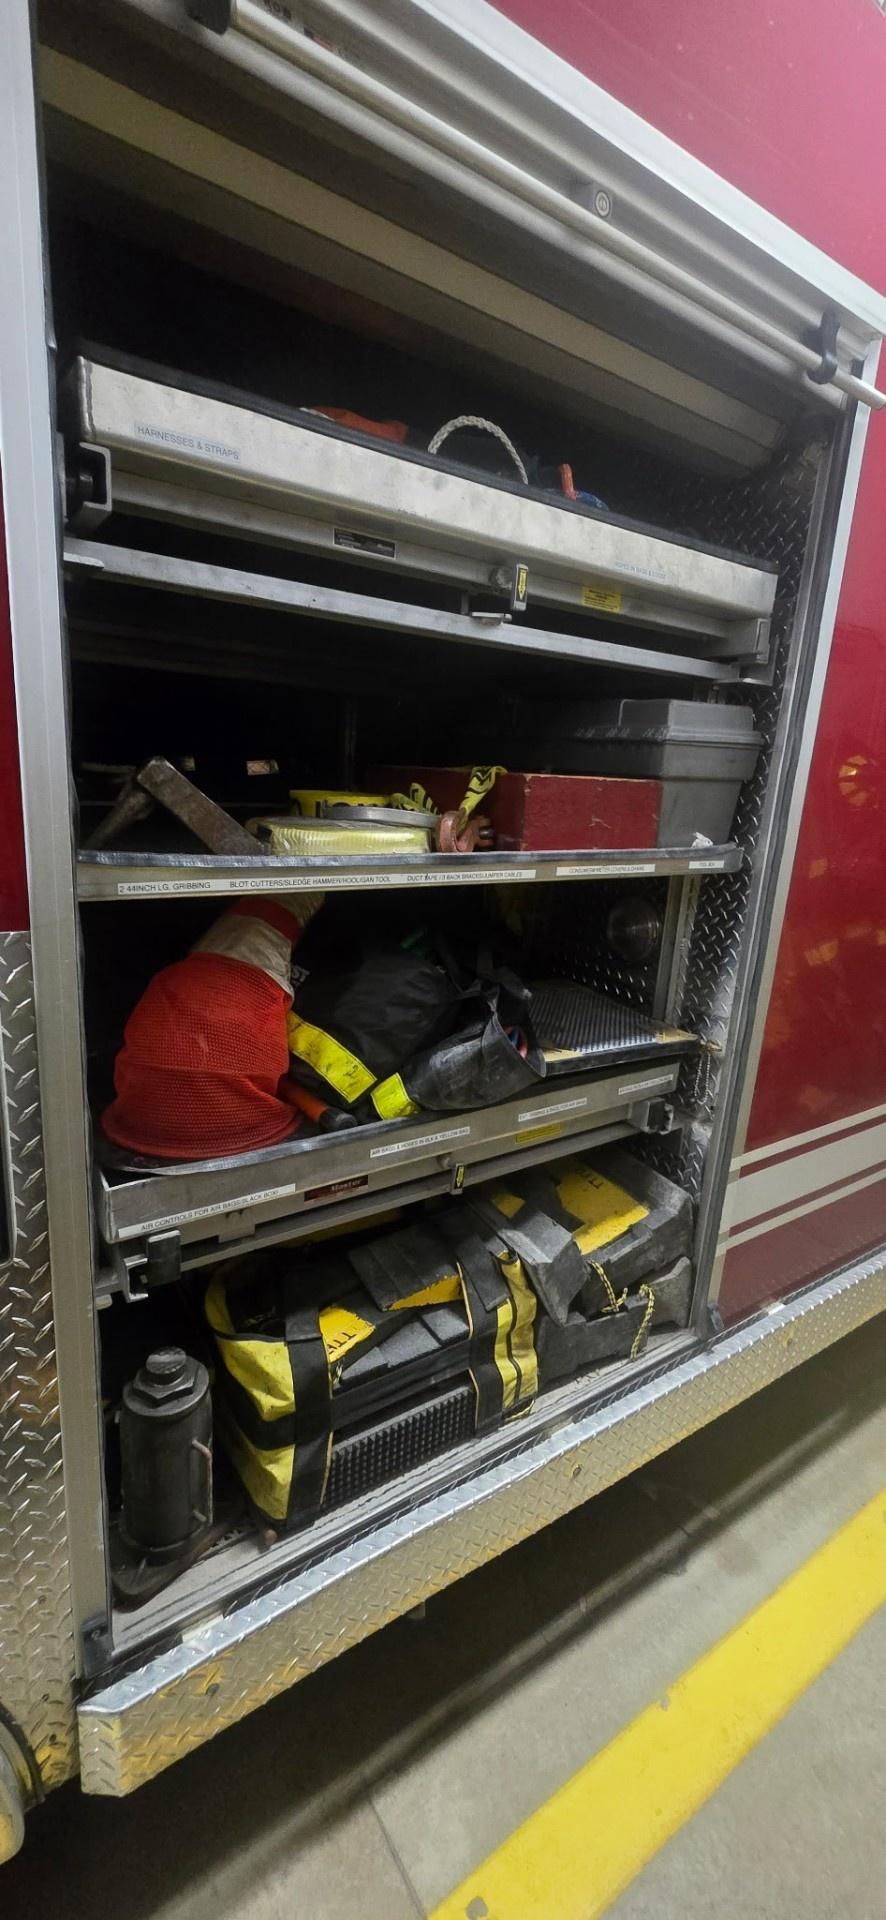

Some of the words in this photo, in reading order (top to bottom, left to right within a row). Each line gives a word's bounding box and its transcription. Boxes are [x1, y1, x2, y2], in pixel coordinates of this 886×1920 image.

[137, 426, 194, 448] HARNESSES
[196, 441, 203, 450] &
[204, 443, 240, 460] STRAPS
[126, 884, 156, 893] 44INCH
[229, 880, 248, 888] BLOT
[375, 875, 391, 883] TOOL
[140, 1222, 153, 1231] AIR
[154, 1211, 193, 1228] CONTROLS
[194, 1207, 209, 1217] FOR
[210, 1204, 222, 1213] AIR
